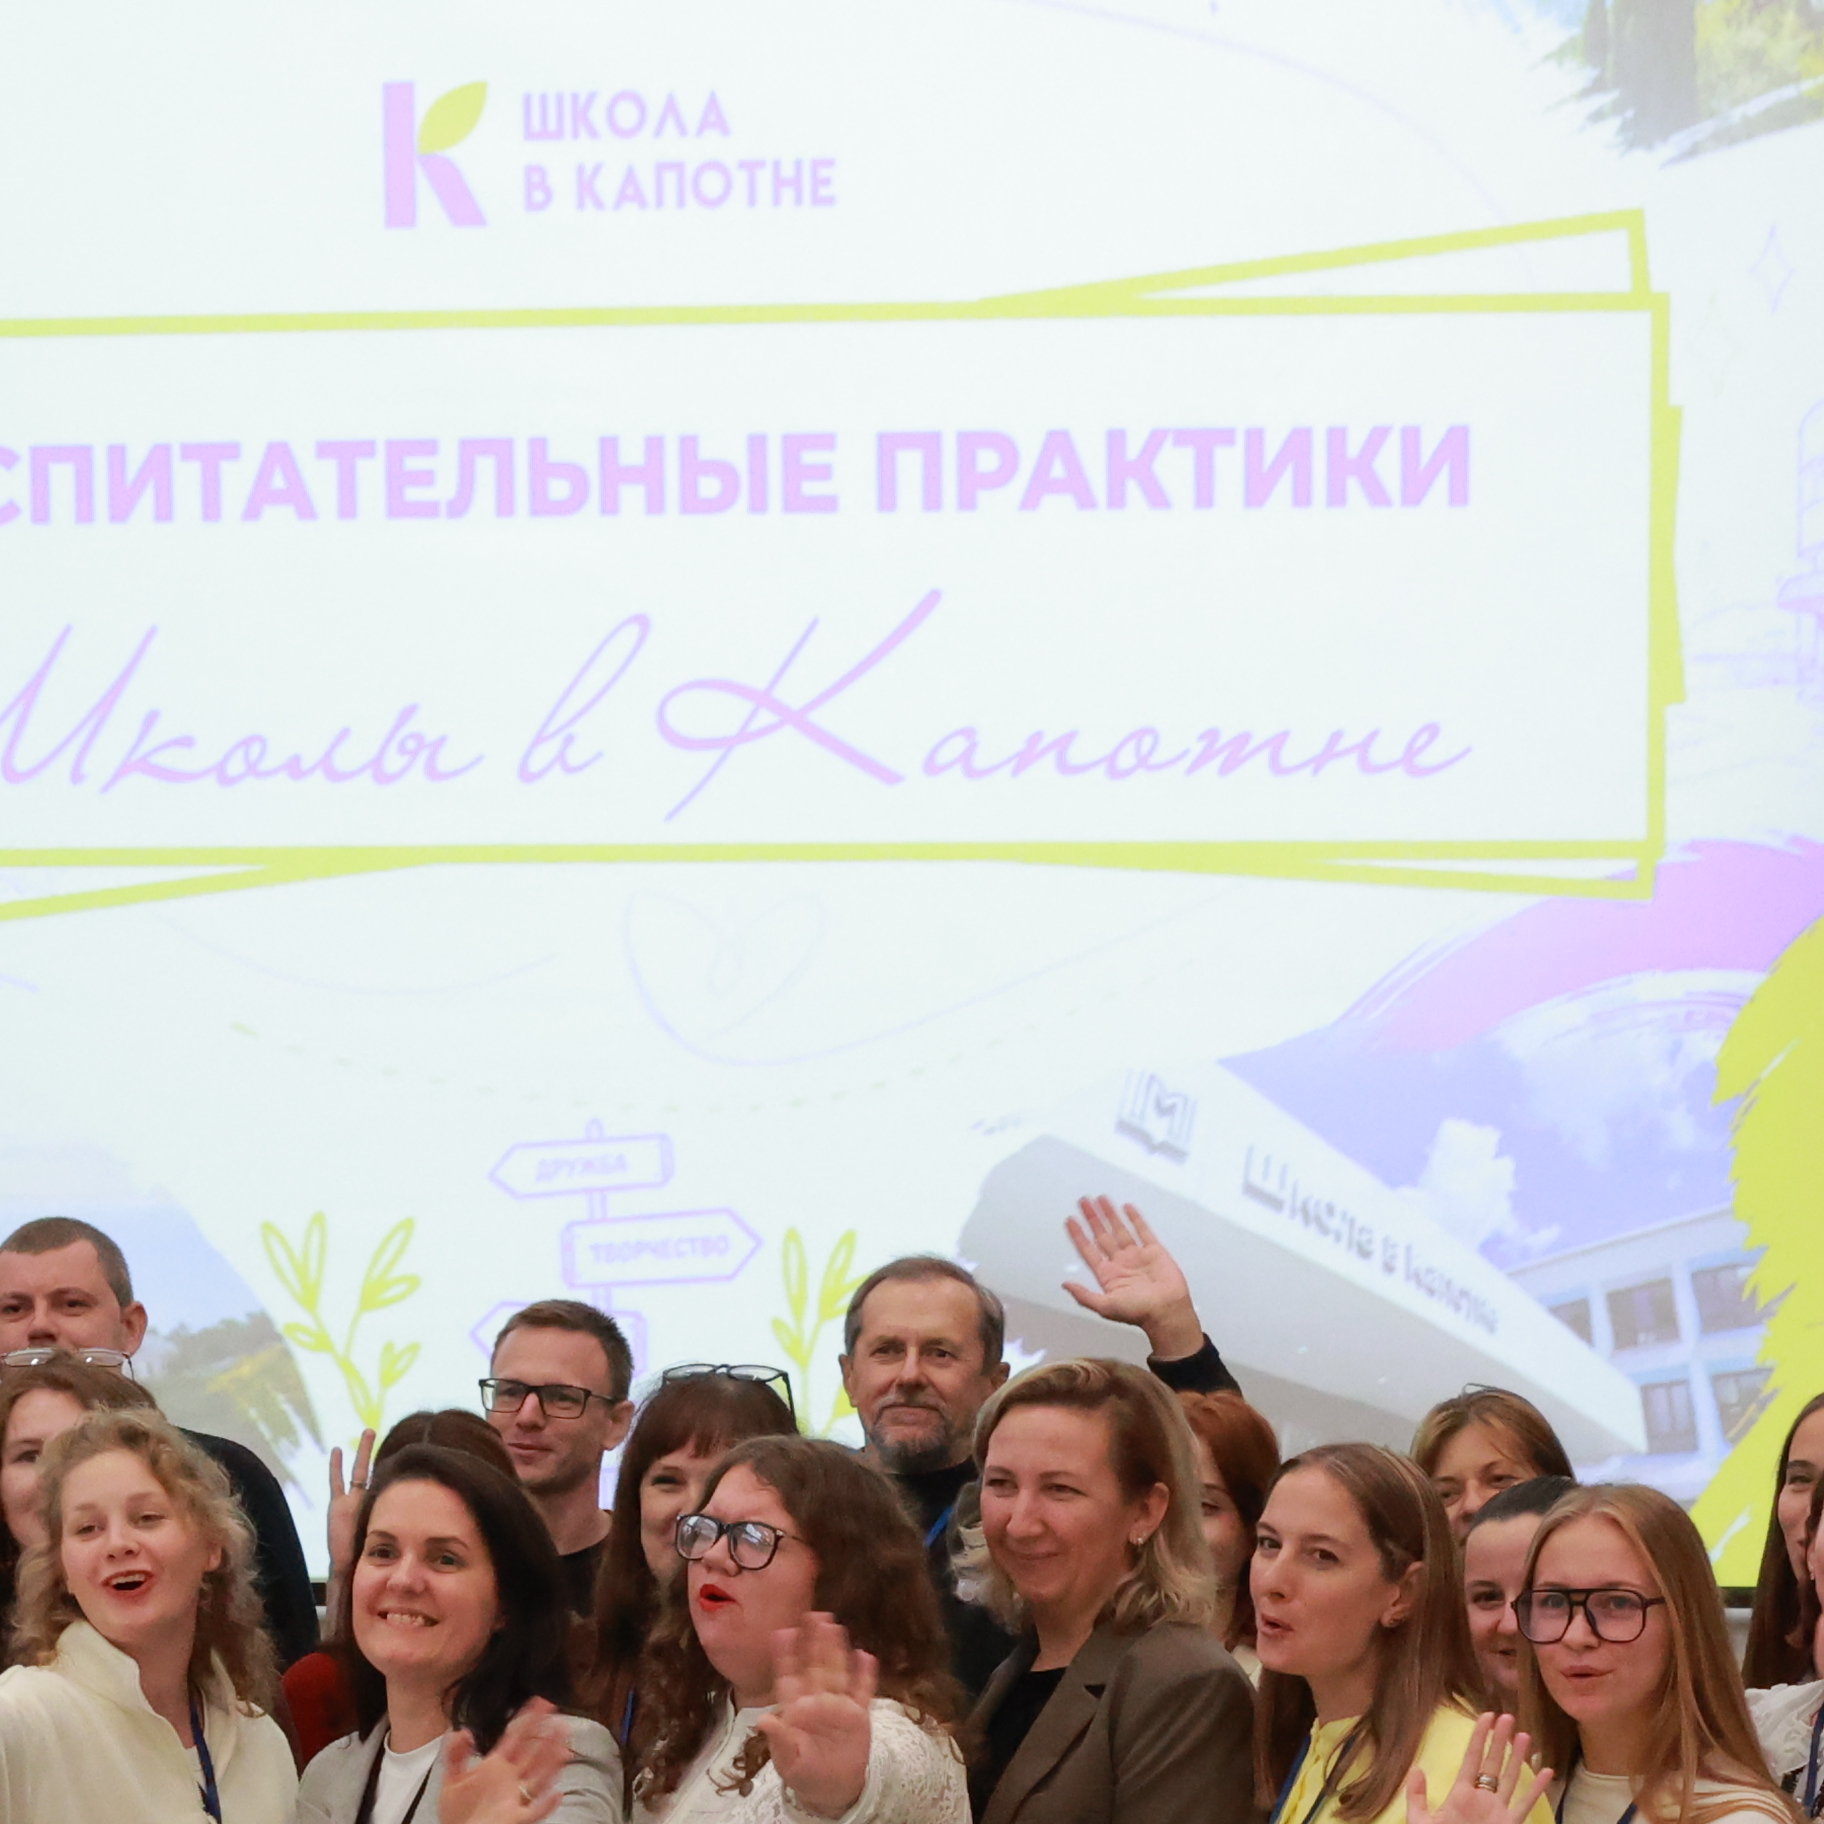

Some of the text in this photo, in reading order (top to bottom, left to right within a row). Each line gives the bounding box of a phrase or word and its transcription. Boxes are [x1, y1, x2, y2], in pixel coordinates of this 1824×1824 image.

[522, 88, 733, 142] ШКОЛА
[523, 157, 838, 213] В КАПОТНЕ
[875, 424, 1472, 515] ПРАКТИКИ
[514, 611, 652, 785] в
[656, 588, 1474, 823] Капотне
[589, 1234, 731, 1264] ТВОРЧЕСТВО
